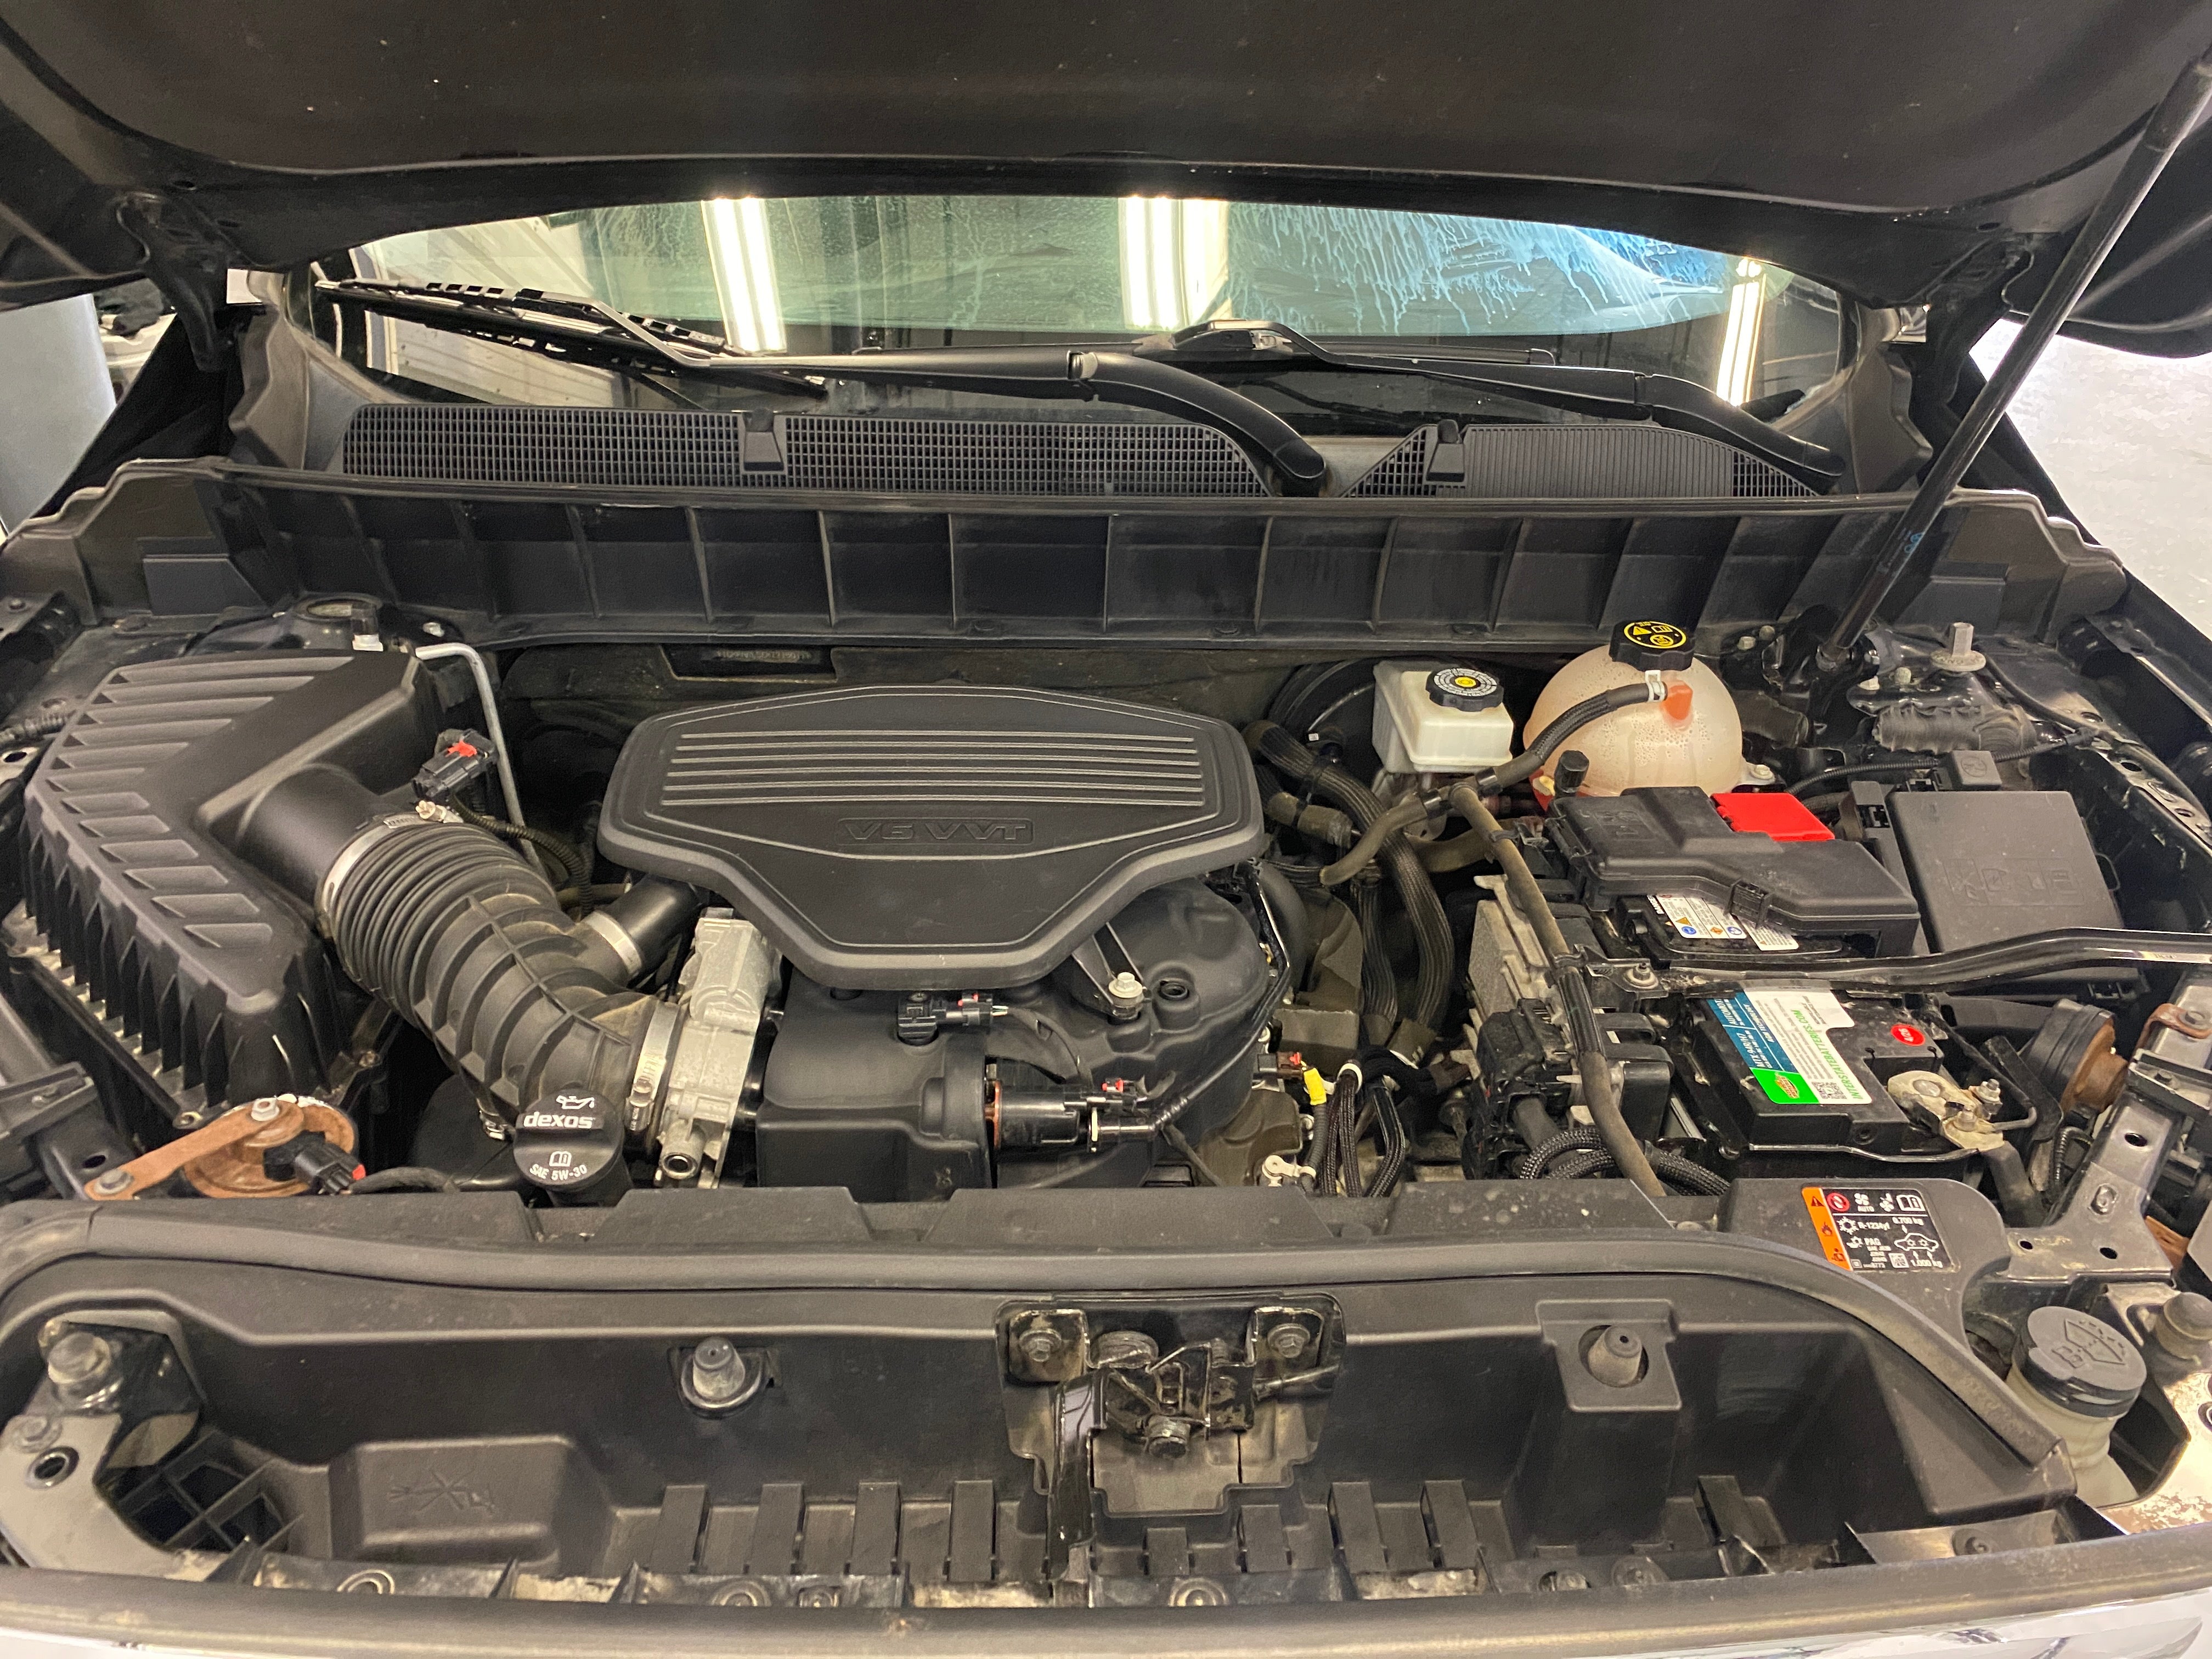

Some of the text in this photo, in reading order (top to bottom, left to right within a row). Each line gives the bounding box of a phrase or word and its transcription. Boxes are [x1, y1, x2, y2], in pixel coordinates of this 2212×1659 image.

[845, 822, 1026, 840] V6 VVT
[1791, 1010, 1863, 1099] INTERSTATEBATTERIES.COM
[523, 1111, 593, 1129] dexos
[529, 1164, 587, 1181] SAE 5W-30
[1912, 1217, 1924, 1226] kg
[1864, 1238, 1882, 1246] PAG
[1932, 1260, 1943, 1268] kg
